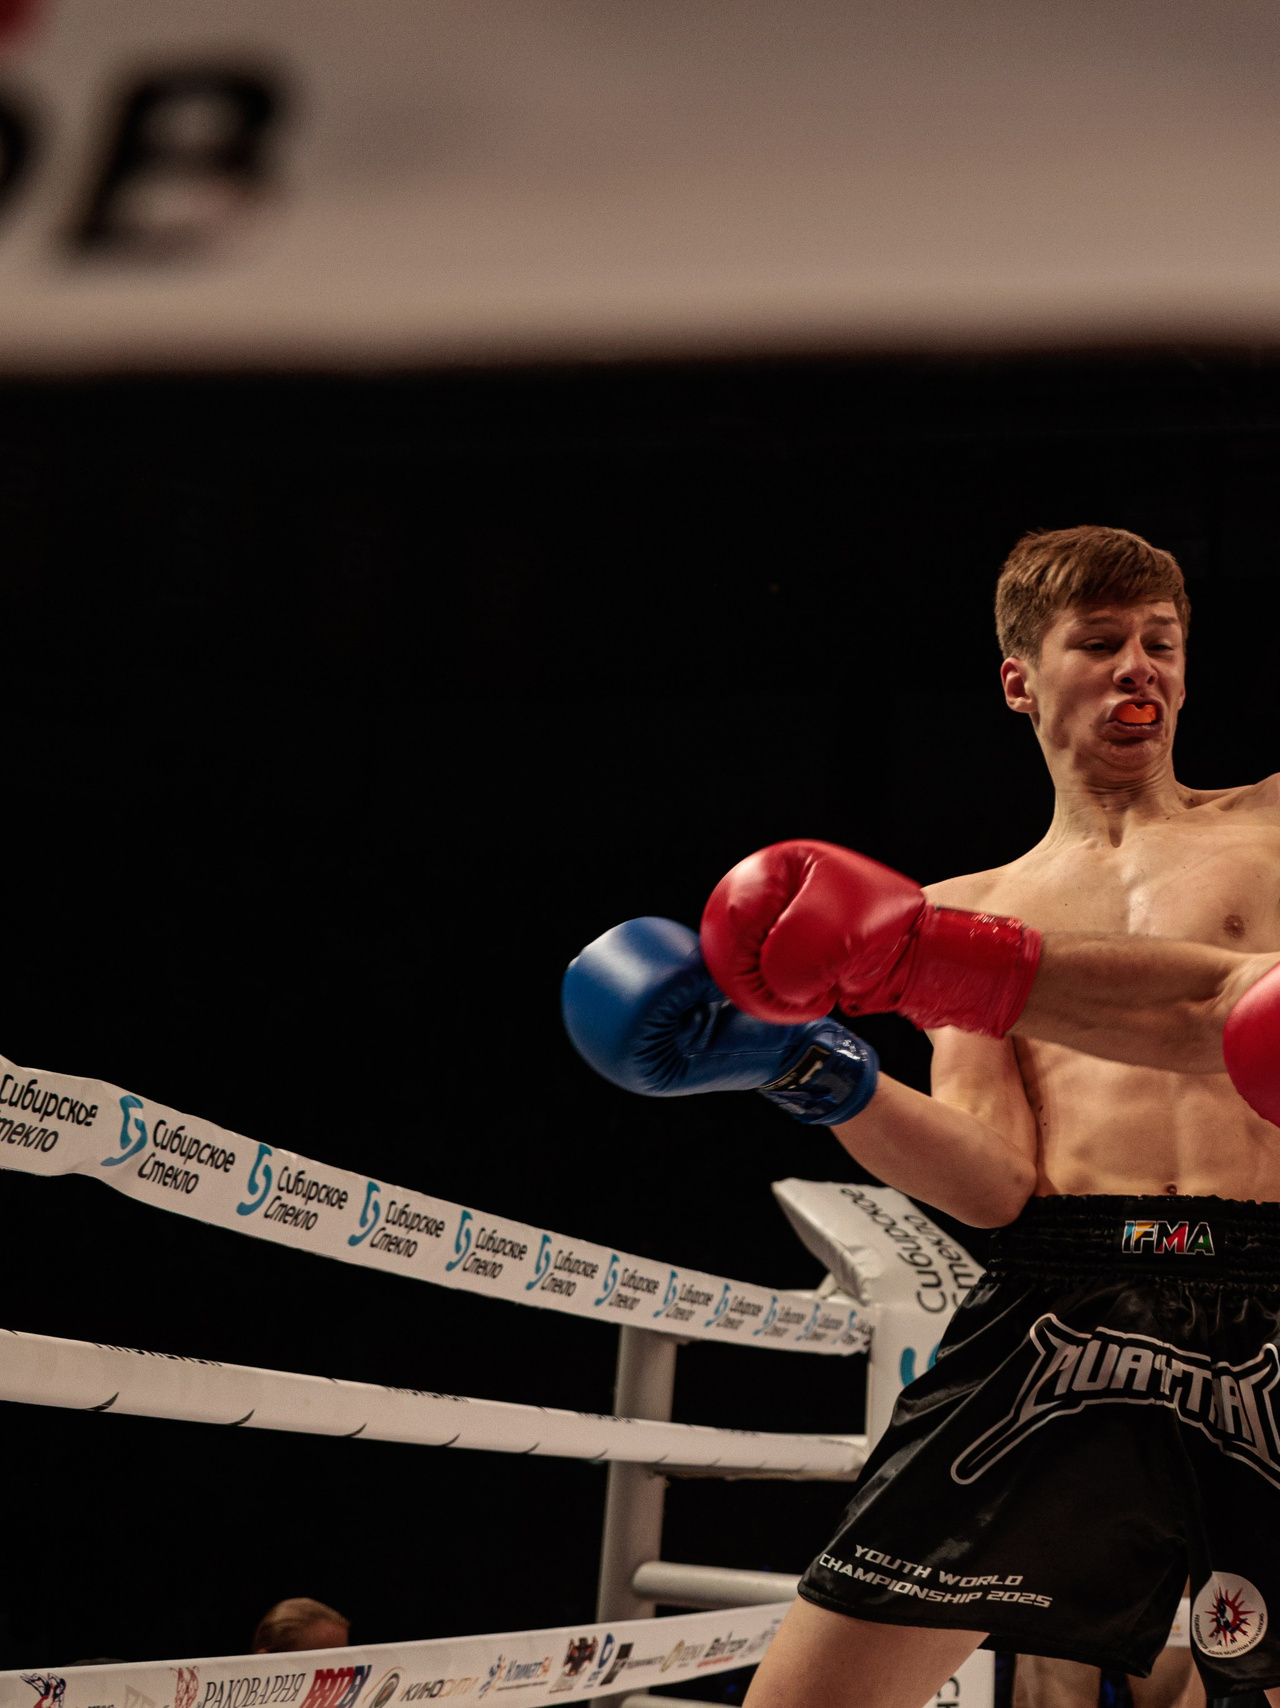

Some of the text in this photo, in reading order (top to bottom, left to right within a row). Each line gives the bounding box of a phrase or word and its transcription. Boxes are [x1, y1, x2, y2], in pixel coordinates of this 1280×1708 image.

[0, 1074, 98, 1127] Сибирское
[0, 1109, 59, 1152] текло
[151, 1119, 236, 1173] Сибирское
[137, 1152, 200, 1194] Стекло
[277, 1166, 349, 1210] Сибирское
[263, 1195, 319, 1232] Стекло
[385, 1200, 446, 1239] Сибирское
[369, 1227, 418, 1258] Стекло
[839, 1188, 948, 1314] Сибирское
[1122, 1220, 1215, 1256] IFMA
[819, 1553, 1053, 1608] CHAMPIONSHIP 2025
[856, 1544, 1023, 1588] YOUTH WORLD
